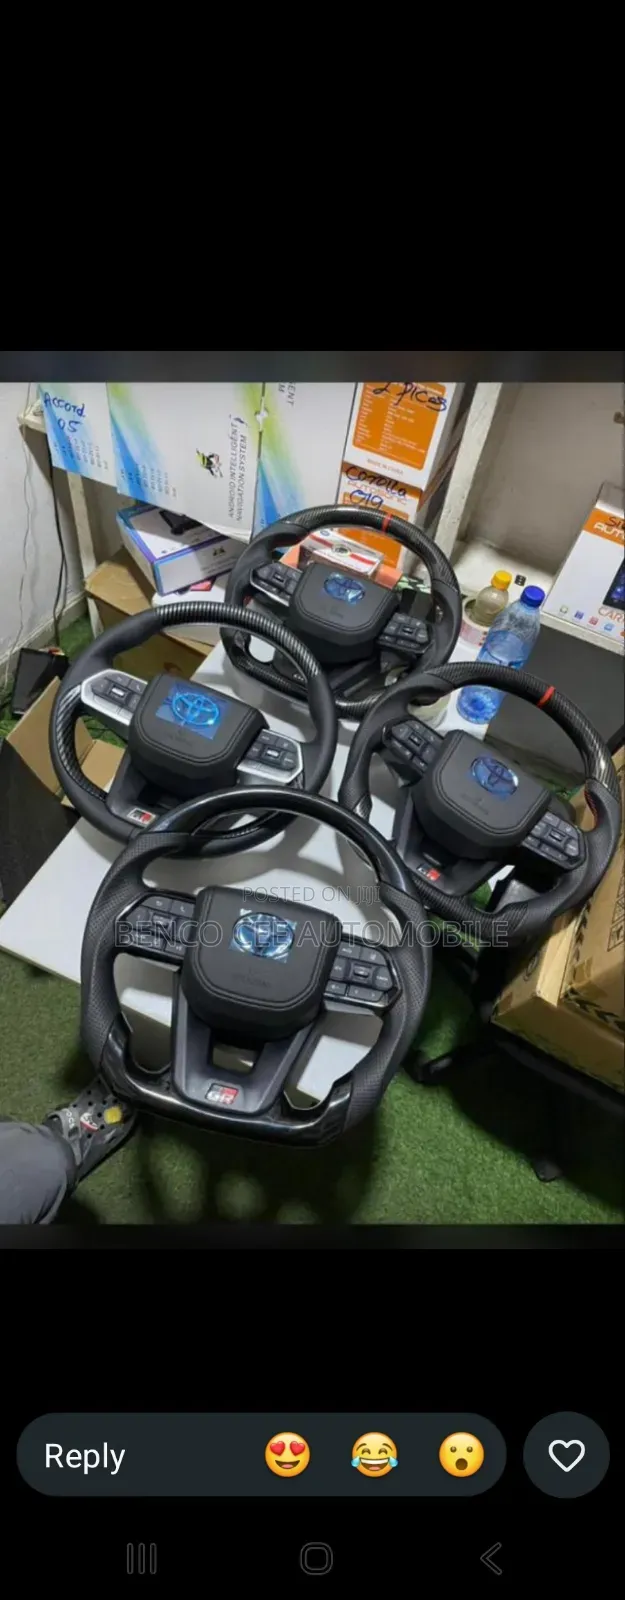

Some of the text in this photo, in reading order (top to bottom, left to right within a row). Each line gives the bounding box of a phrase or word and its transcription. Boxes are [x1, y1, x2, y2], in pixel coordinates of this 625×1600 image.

[228, 422, 238, 519] ANDROID INTELLIGENT
[236, 435, 247, 521] NAVIGATION SYSTEM
[45, 1442, 126, 1475] Reply
